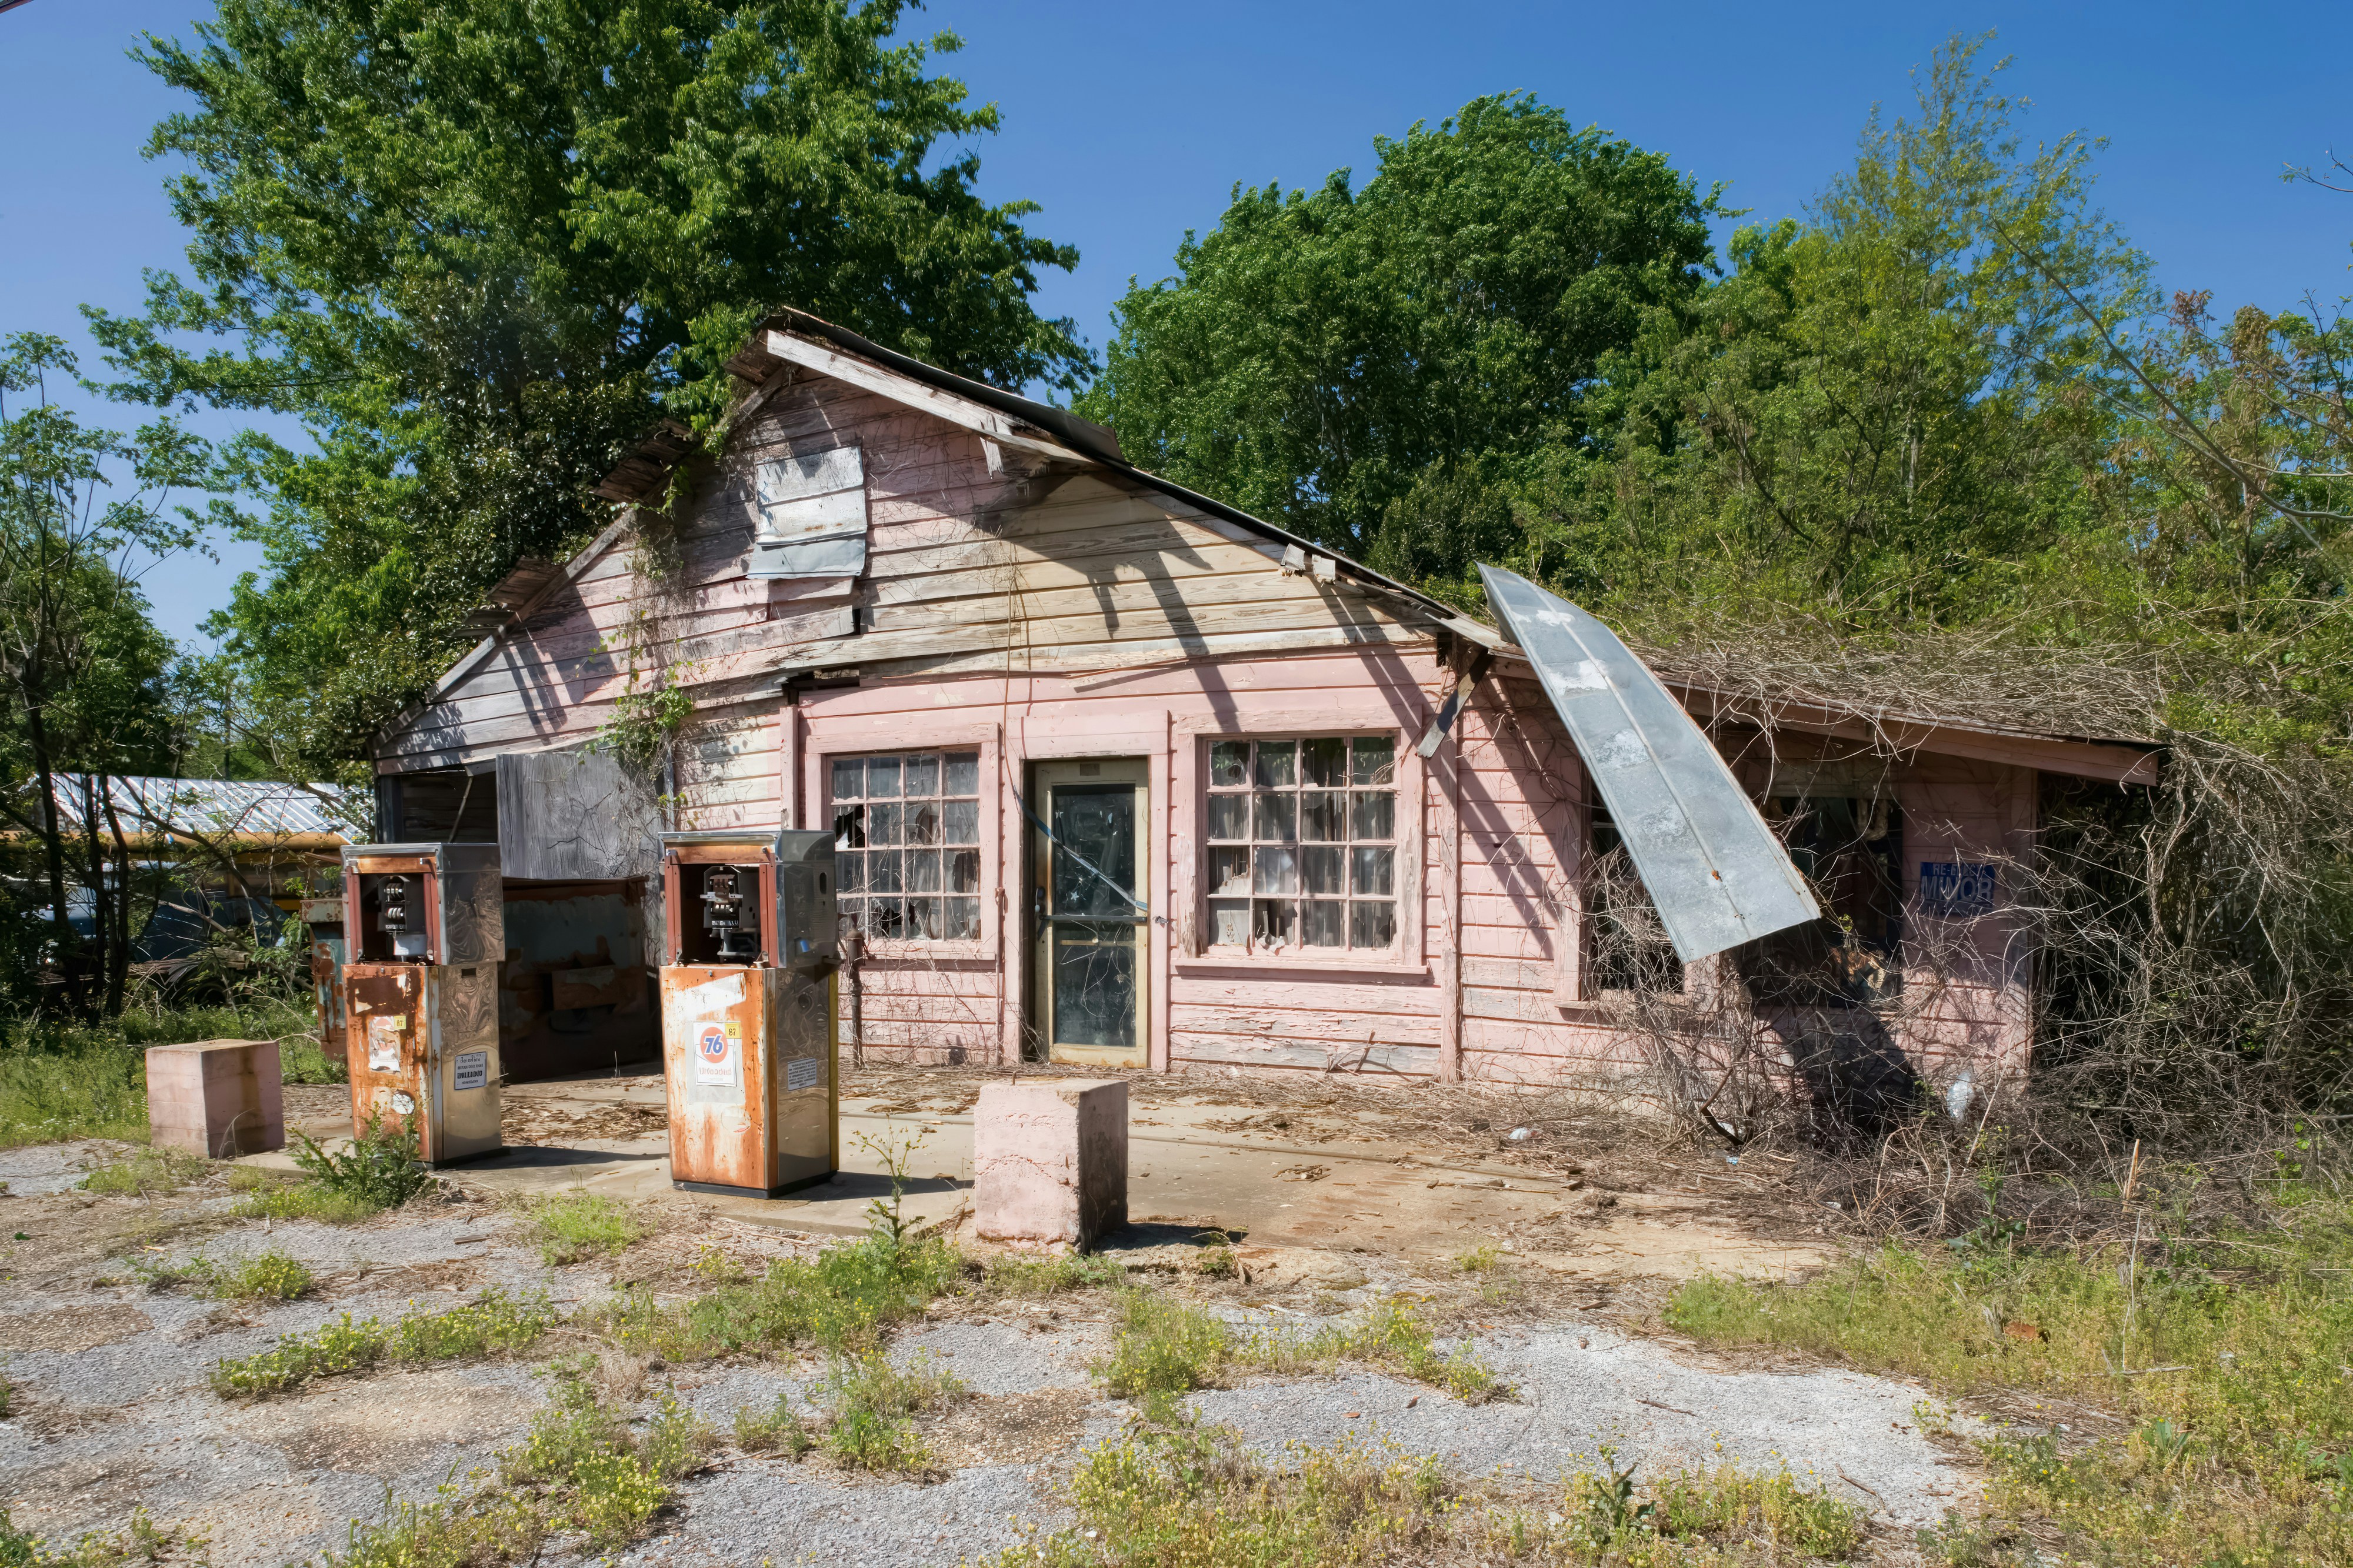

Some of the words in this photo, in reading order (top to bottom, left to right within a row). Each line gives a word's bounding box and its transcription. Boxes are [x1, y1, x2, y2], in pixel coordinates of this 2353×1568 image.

[1933, 863, 1982, 876] RE-EEC
[1921, 876, 1992, 902] MINOR
[704, 1034, 723, 1056] 76
